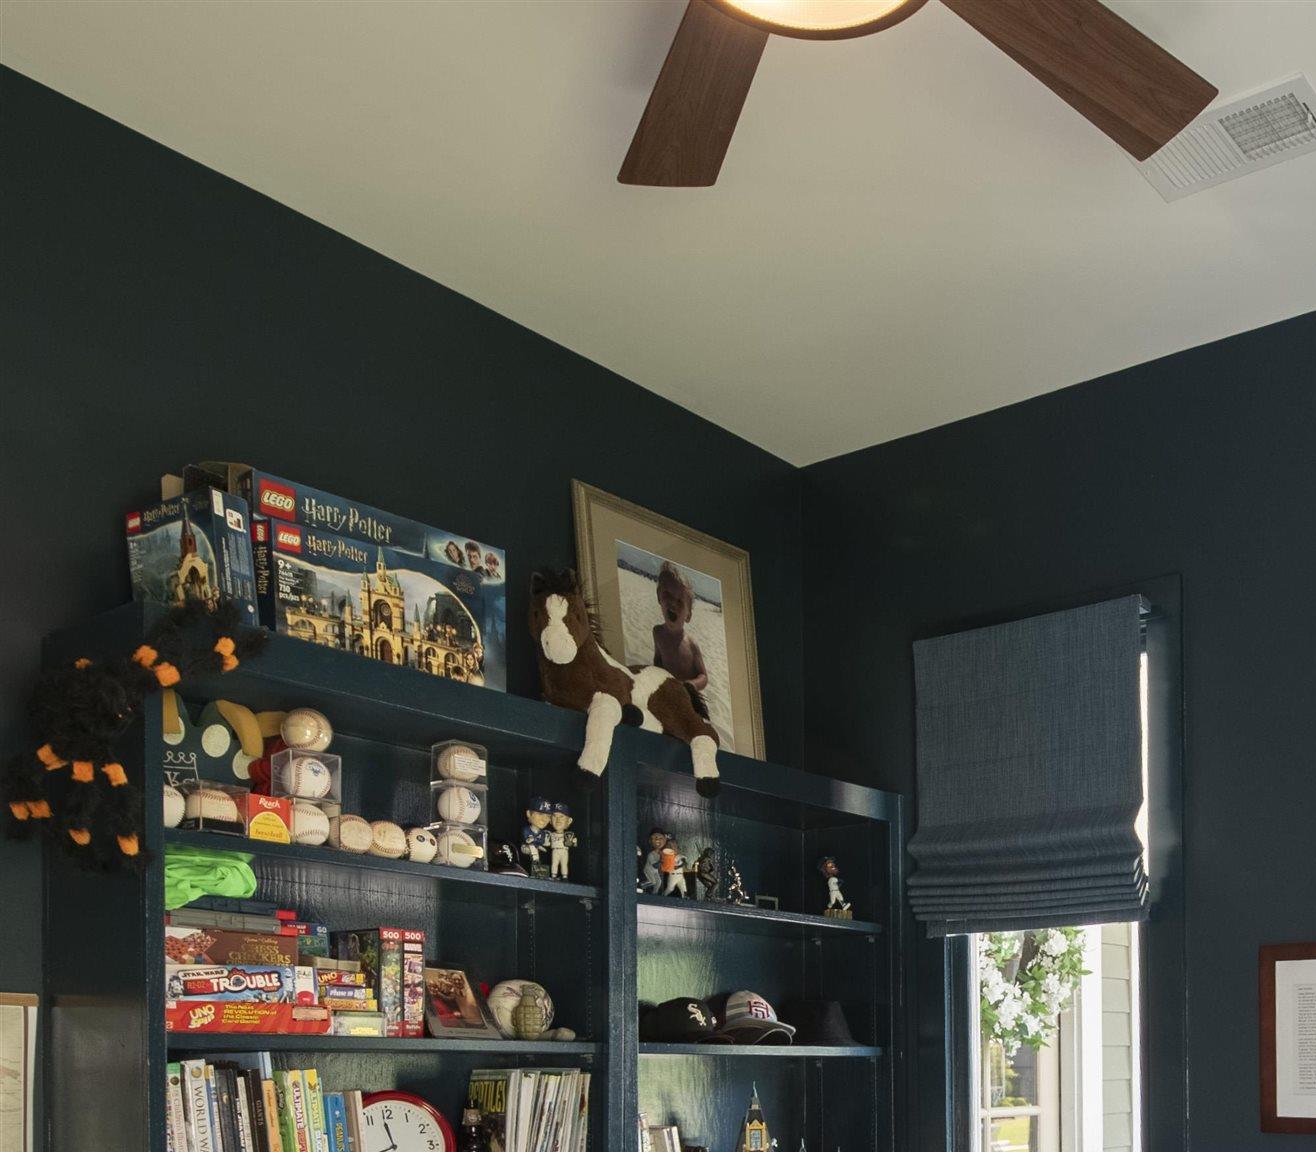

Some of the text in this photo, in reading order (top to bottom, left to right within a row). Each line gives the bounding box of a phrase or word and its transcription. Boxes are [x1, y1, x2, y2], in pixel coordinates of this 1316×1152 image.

[262, 490, 295, 511] LEGO
[302, 497, 392, 543] Harry Potter
[278, 532, 301, 547] LEGO
[306, 535, 368, 564] Harry Potter
[278, 560, 292, 569] 9+
[382, 931, 399, 939] 500
[405, 931, 421, 940] 500
[210, 972, 281, 992] TROUBLE
[318, 972, 337, 983] UNO
[189, 1004, 215, 1019] UNO
[194, 1086, 207, 1134] WORLD
[293, 1086, 304, 1129] ULTIMATE
[309, 1088, 321, 1129] ULTIMATE
[381, 1109, 393, 1120] 12
[365, 1115, 374, 1126] 11
[419, 1124, 427, 1134] 2
[335, 1122, 344, 1152] PEANUTS
[427, 1140, 435, 1150] 3
